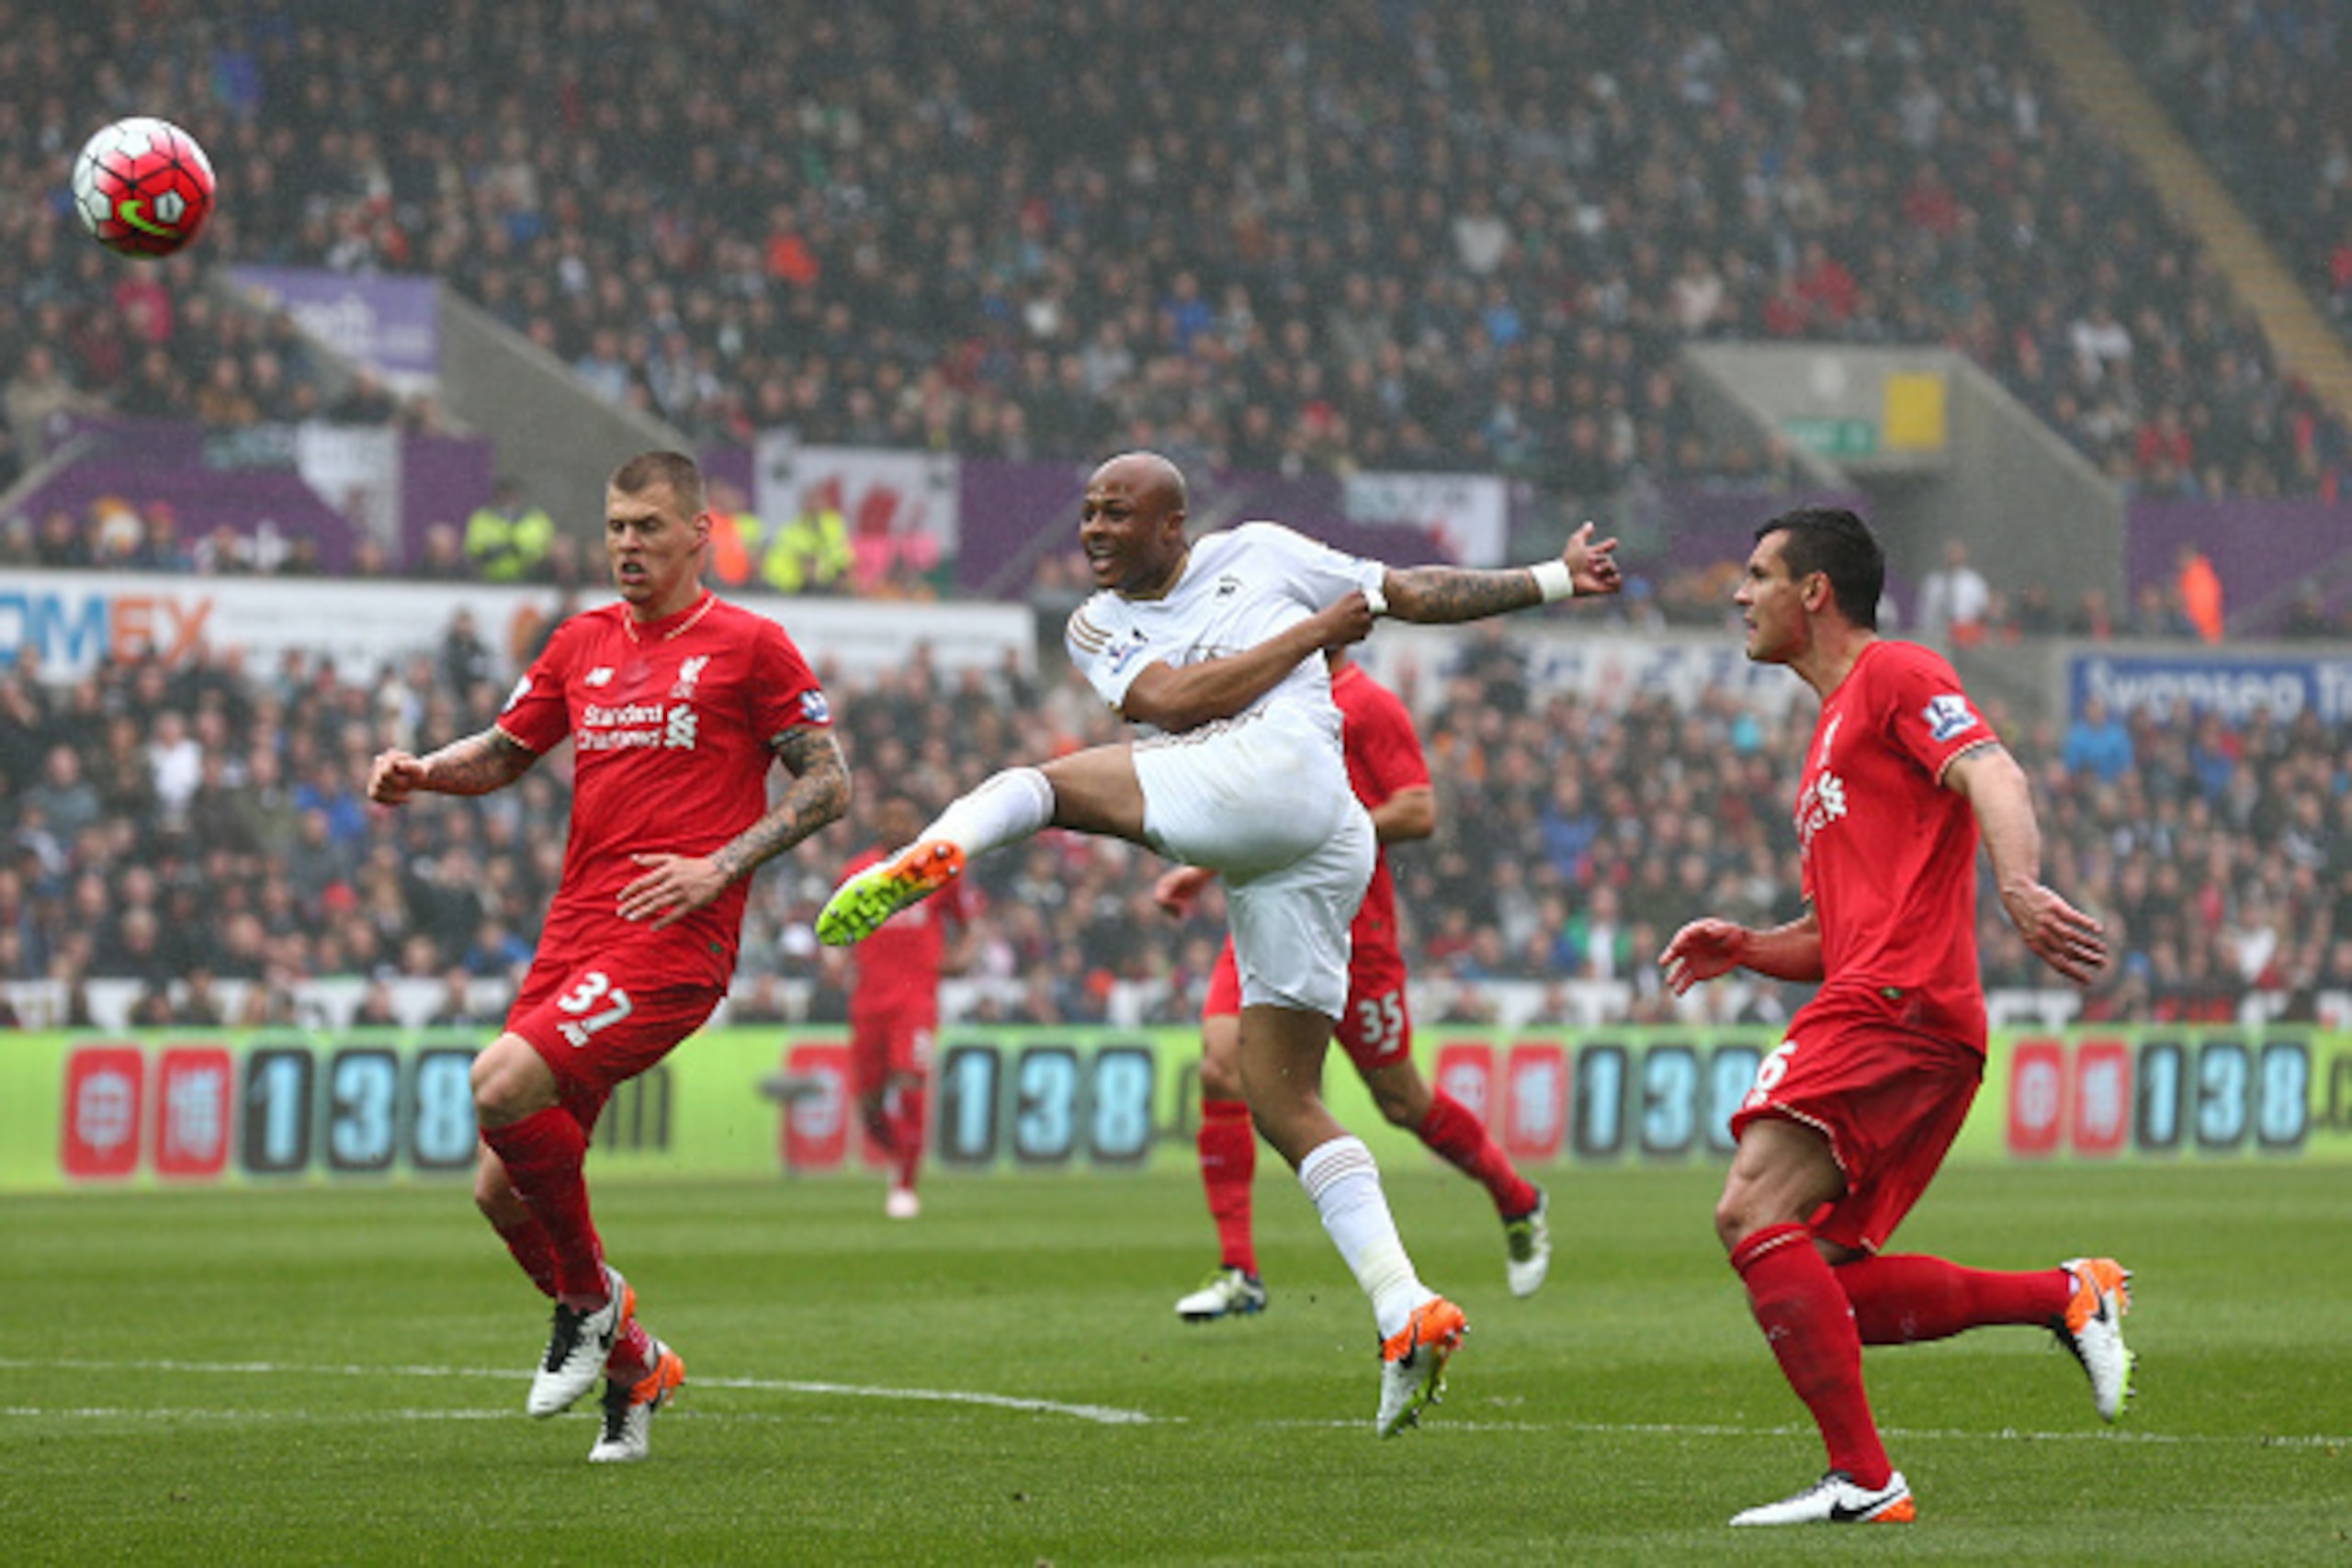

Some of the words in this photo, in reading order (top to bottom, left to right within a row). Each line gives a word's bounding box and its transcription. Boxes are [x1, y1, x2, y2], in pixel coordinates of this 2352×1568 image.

[582, 703, 663, 727] Standard
[556, 970, 634, 1036] 37
[1357, 989, 1404, 1044] 35
[1756, 1040, 1798, 1091] 6
